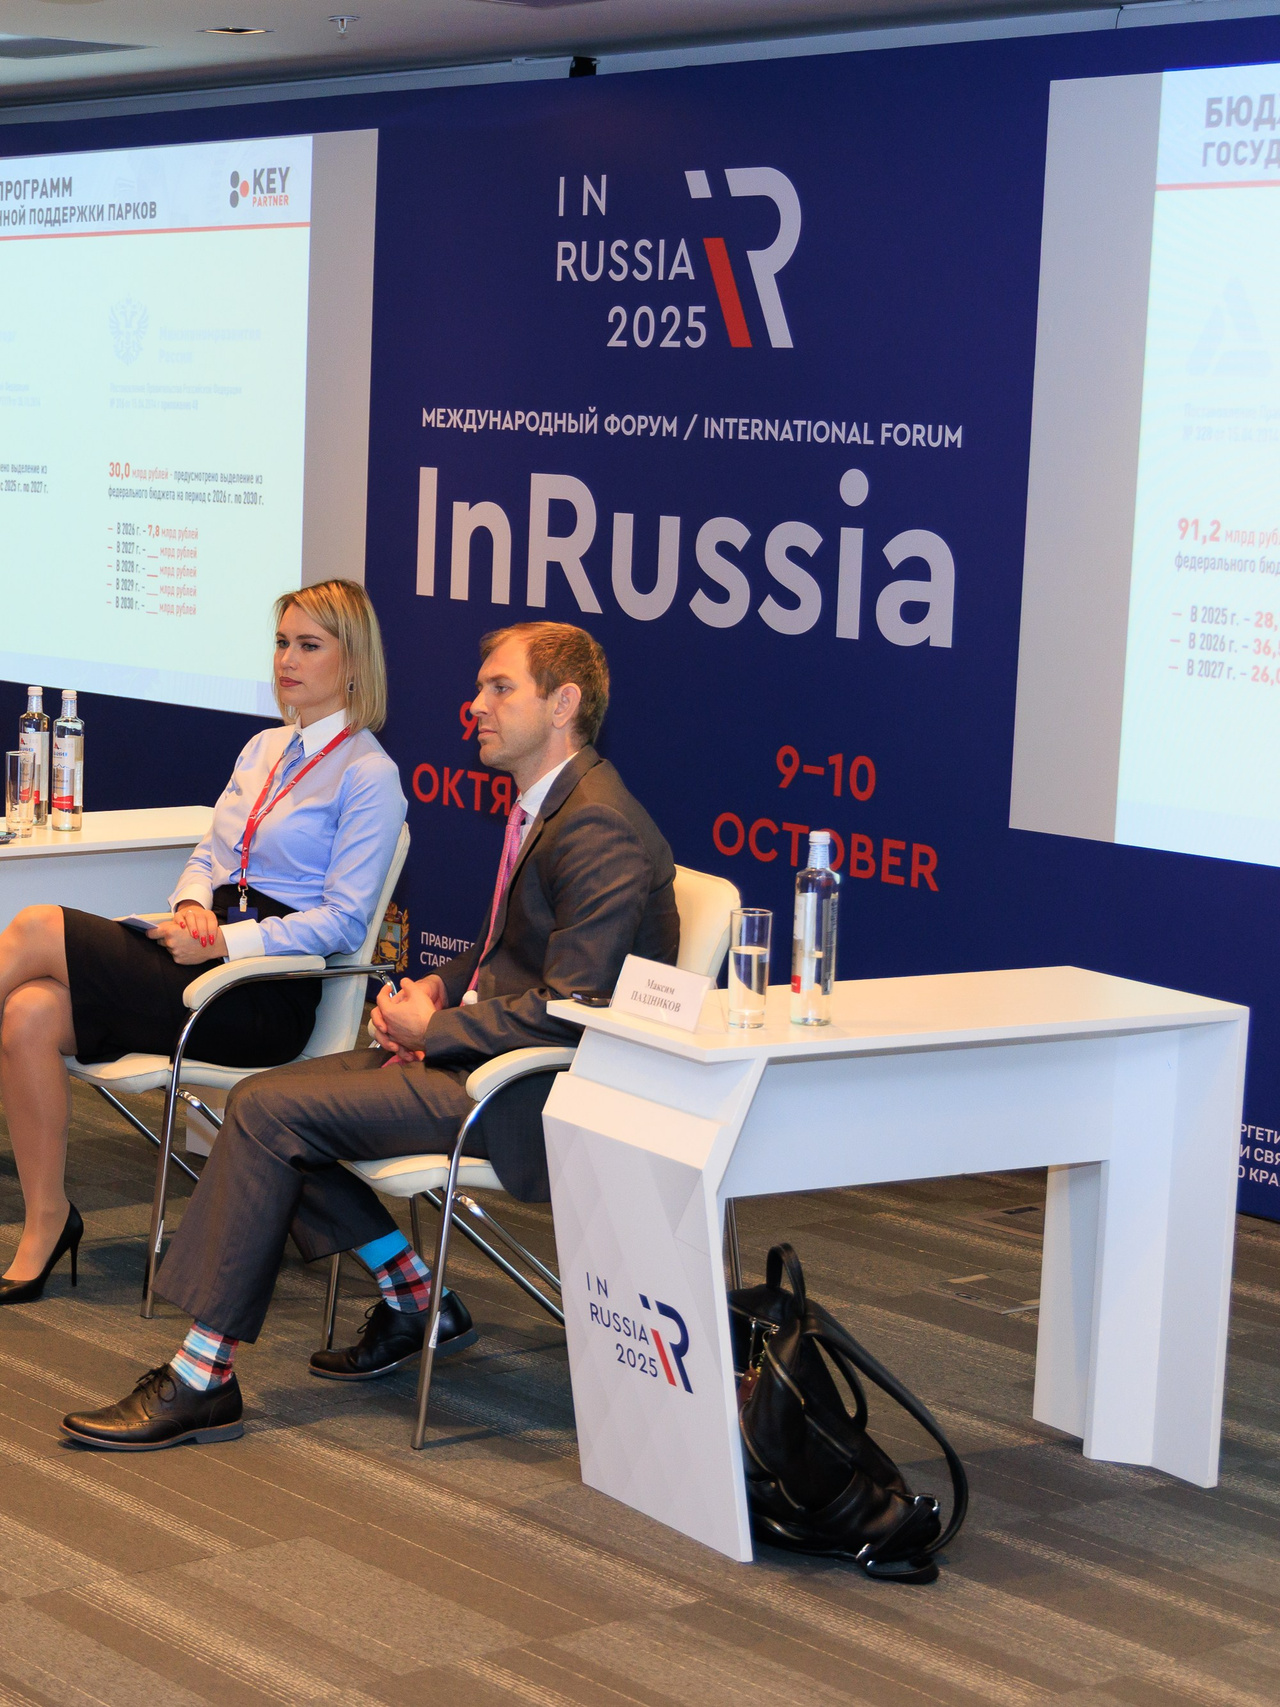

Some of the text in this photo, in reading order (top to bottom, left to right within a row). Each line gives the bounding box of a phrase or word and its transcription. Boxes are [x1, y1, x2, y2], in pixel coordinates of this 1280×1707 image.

[1205, 93, 1280, 132] БЮД
[252, 166, 290, 195] KEY
[252, 194, 290, 207] PARTNER
[557, 174, 608, 217] IN
[29, 206, 104, 227] ПОДДЕРЖКИ
[107, 201, 157, 221] ПАРКОВ
[556, 237, 695, 282] RUSSIA
[606, 305, 707, 349] 2025
[421, 406, 598, 437] МЕЖДУНАРОДНЫЙ
[604, 413, 678, 439] ФОРУМ
[703, 417, 874, 446] INTERNATIONAL
[880, 423, 963, 449] FORUM
[109, 462, 130, 479] 30,0
[1178, 517, 1221, 545] 91,2
[1225, 529, 1255, 546] млрд
[416, 466, 955, 648] InRussia
[1174, 551, 1256, 574] федерального
[1190, 605, 1197, 623] В
[1201, 606, 1227, 625] 2025
[1189, 632, 1196, 650] В
[1200, 633, 1225, 652] 2026
[1187, 659, 1194, 676] В
[1198, 660, 1224, 679] 2027
[412, 763, 520, 817] ОКТЯ
[645, 978, 675, 995] Максим
[630, 990, 681, 1013] ПАЗДНИКОВ
[586, 1271, 608, 1299] IN
[590, 1302, 650, 1345] RUSSIA
[616, 1343, 658, 1378] 2025
